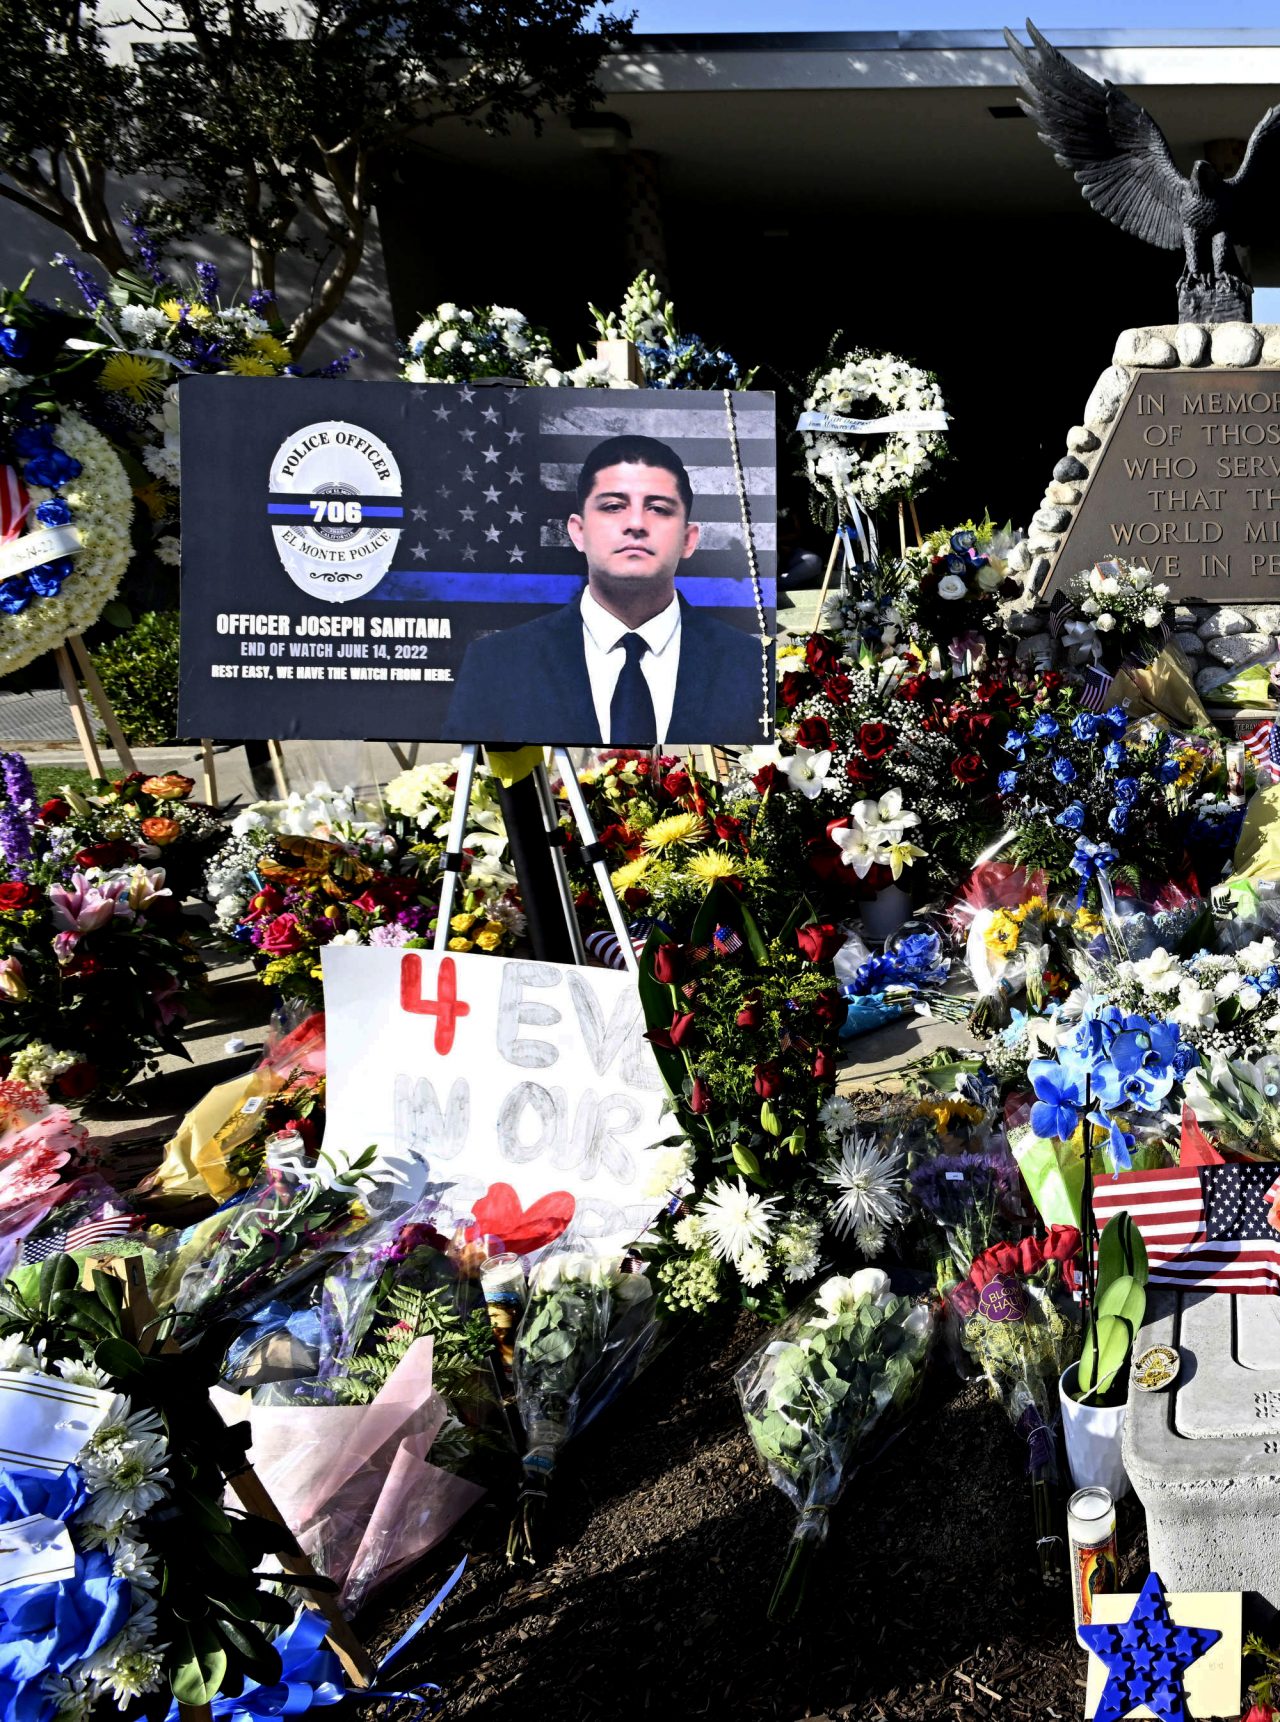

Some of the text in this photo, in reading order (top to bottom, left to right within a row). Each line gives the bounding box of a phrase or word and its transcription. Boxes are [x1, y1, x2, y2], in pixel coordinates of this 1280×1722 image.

[1137, 393, 1165, 416] IN
[1143, 424, 1182, 447] OF
[281, 431, 391, 481] POLICE OFFICER
[1122, 457, 1197, 480] WHO
[309, 500, 362, 524] 706
[1148, 489, 1227, 512] THAT
[281, 530, 392, 562] EL MONTE POLICE
[1110, 522, 1224, 546] WORLD
[1129, 554, 1181, 578] IVE
[1200, 554, 1231, 578] IN
[216, 613, 451, 639] OFFICER JOSEPH SANTANA
[240, 641, 428, 660] END OF WATCH JUNE 14, 2022
[211, 664, 455, 682] REST EASY, WE HAVE THE WATCH FROM HERE.
[401, 952, 471, 1056] 4
[497, 1080, 645, 1186] OUR
